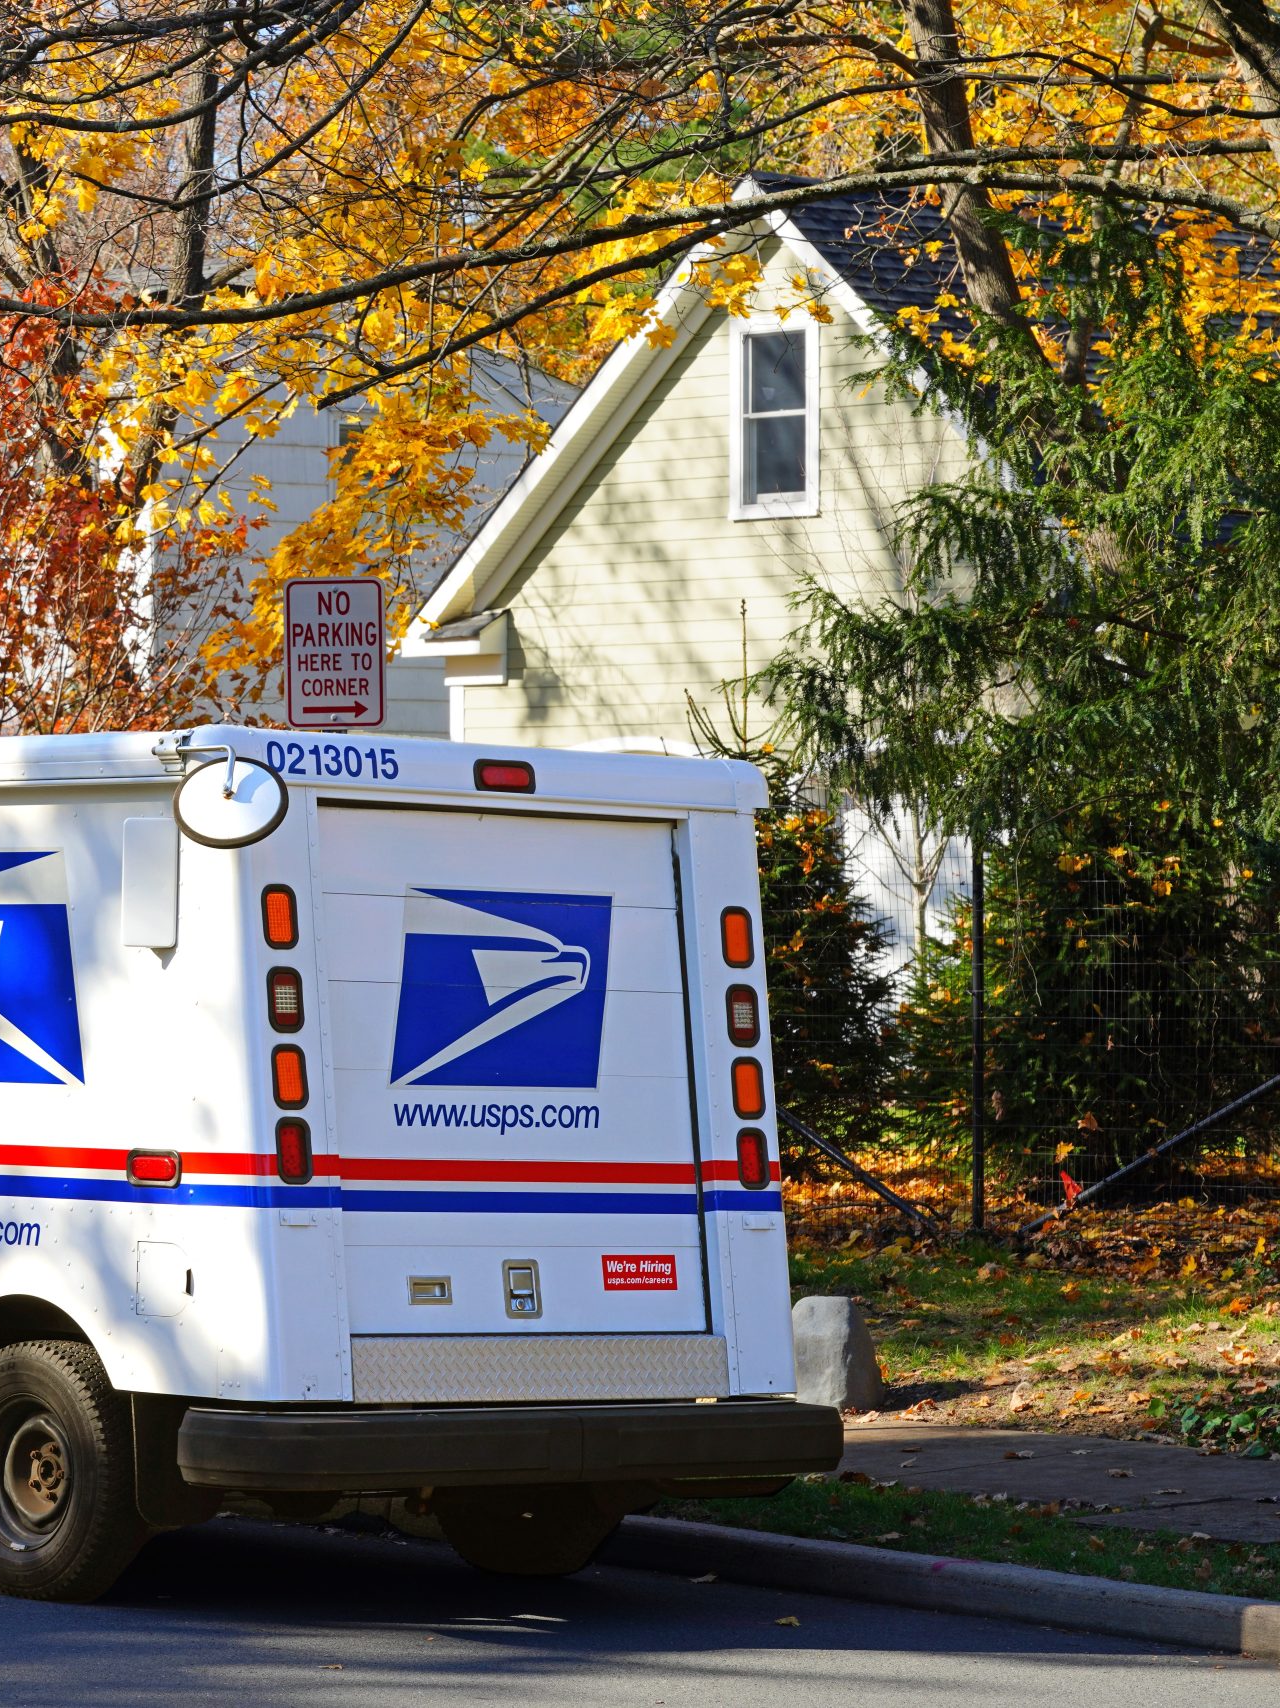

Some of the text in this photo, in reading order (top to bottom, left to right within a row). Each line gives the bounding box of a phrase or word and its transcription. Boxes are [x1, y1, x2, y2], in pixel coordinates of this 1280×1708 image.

[317, 591, 350, 615] NO
[292, 621, 377, 647] PARKING
[297, 652, 372, 671] HERE TO
[301, 678, 369, 697] CORNER
[266, 740, 399, 780] 0213015
[394, 1103, 600, 1136] www.usps.com
[606, 1260, 672, 1275] We're Hiring
[607, 1276, 673, 1286] usps.com/careers
